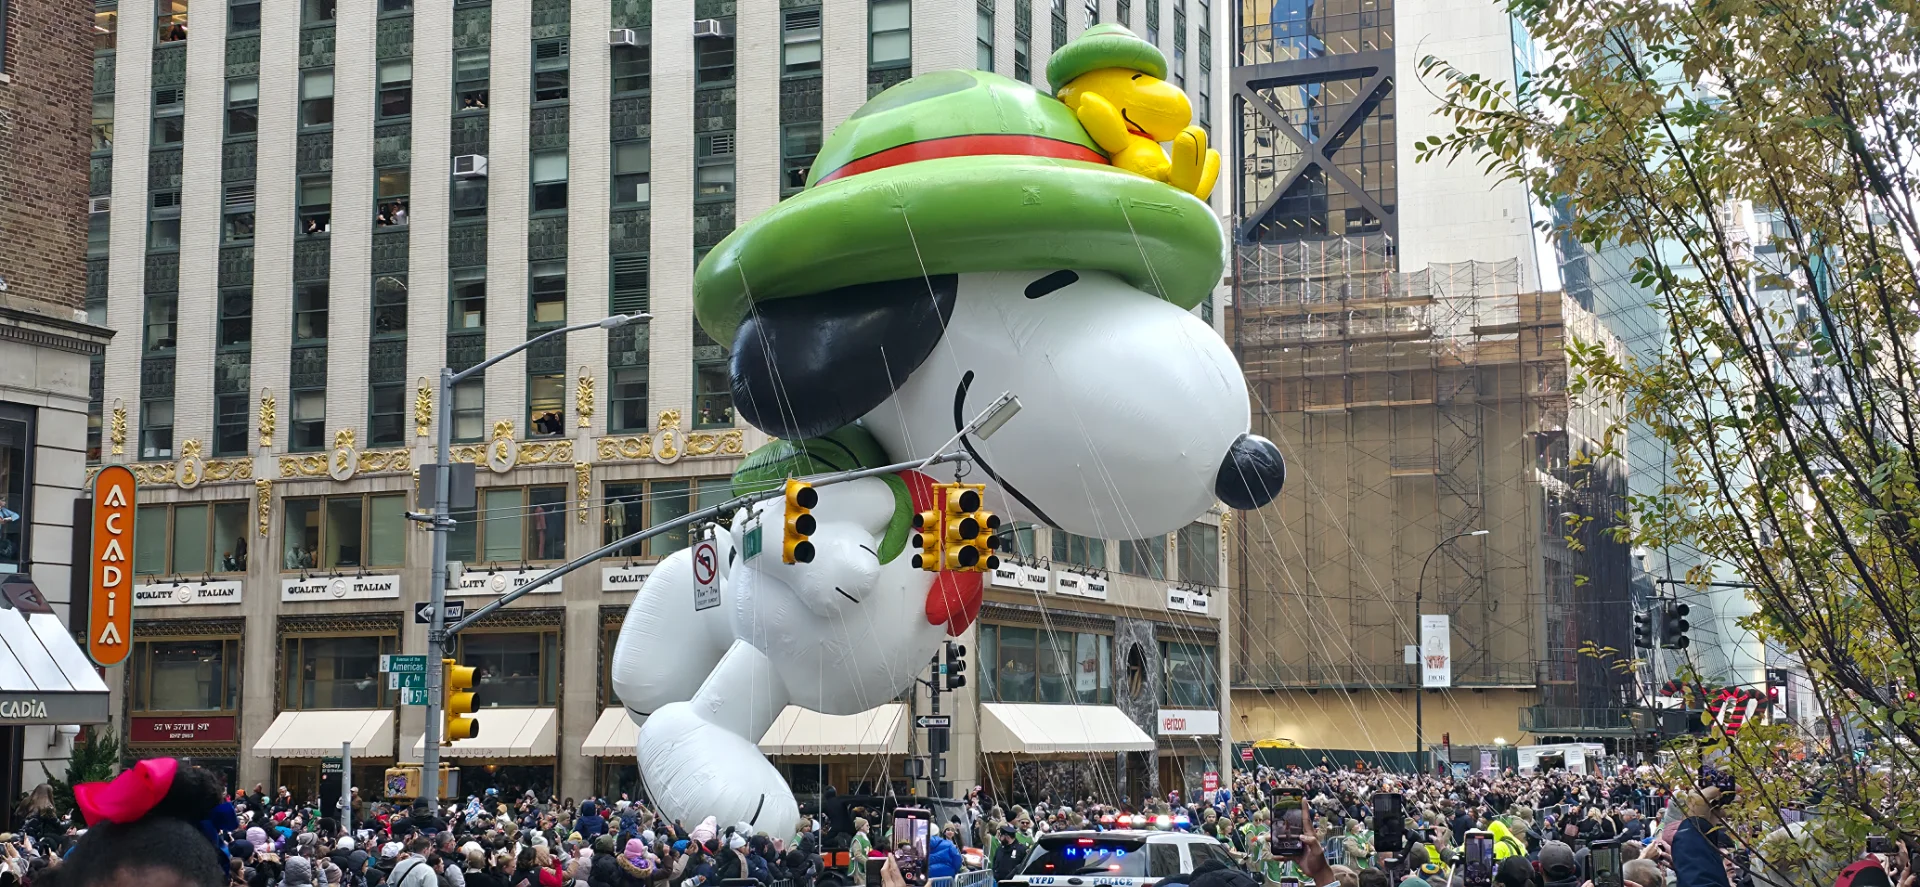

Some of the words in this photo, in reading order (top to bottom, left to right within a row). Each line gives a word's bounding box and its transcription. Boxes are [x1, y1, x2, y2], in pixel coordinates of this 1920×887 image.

[288, 585, 327, 595] QUALITY
[353, 582, 392, 592] ITALIAN
[460, 579, 486, 589] LITY
[136, 589, 173, 600] QUALITY
[197, 588, 234, 597] ITALIAN
[447, 608, 460, 616] WAY
[392, 662, 424, 671] Americas
[404, 675, 410, 687] 6
[414, 674, 421, 682] Av
[415, 690, 423, 703] 57
[153, 723, 163, 731] 57
[164, 723, 173, 731] W
[173, 723, 194, 731] 57TH
[197, 723, 210, 731] ST
[1163, 718, 1187, 731] verizon
[321, 762, 341, 771] Subway
[1028, 876, 1055, 885] NYPD
[1092, 877, 1133, 886] POLICE
